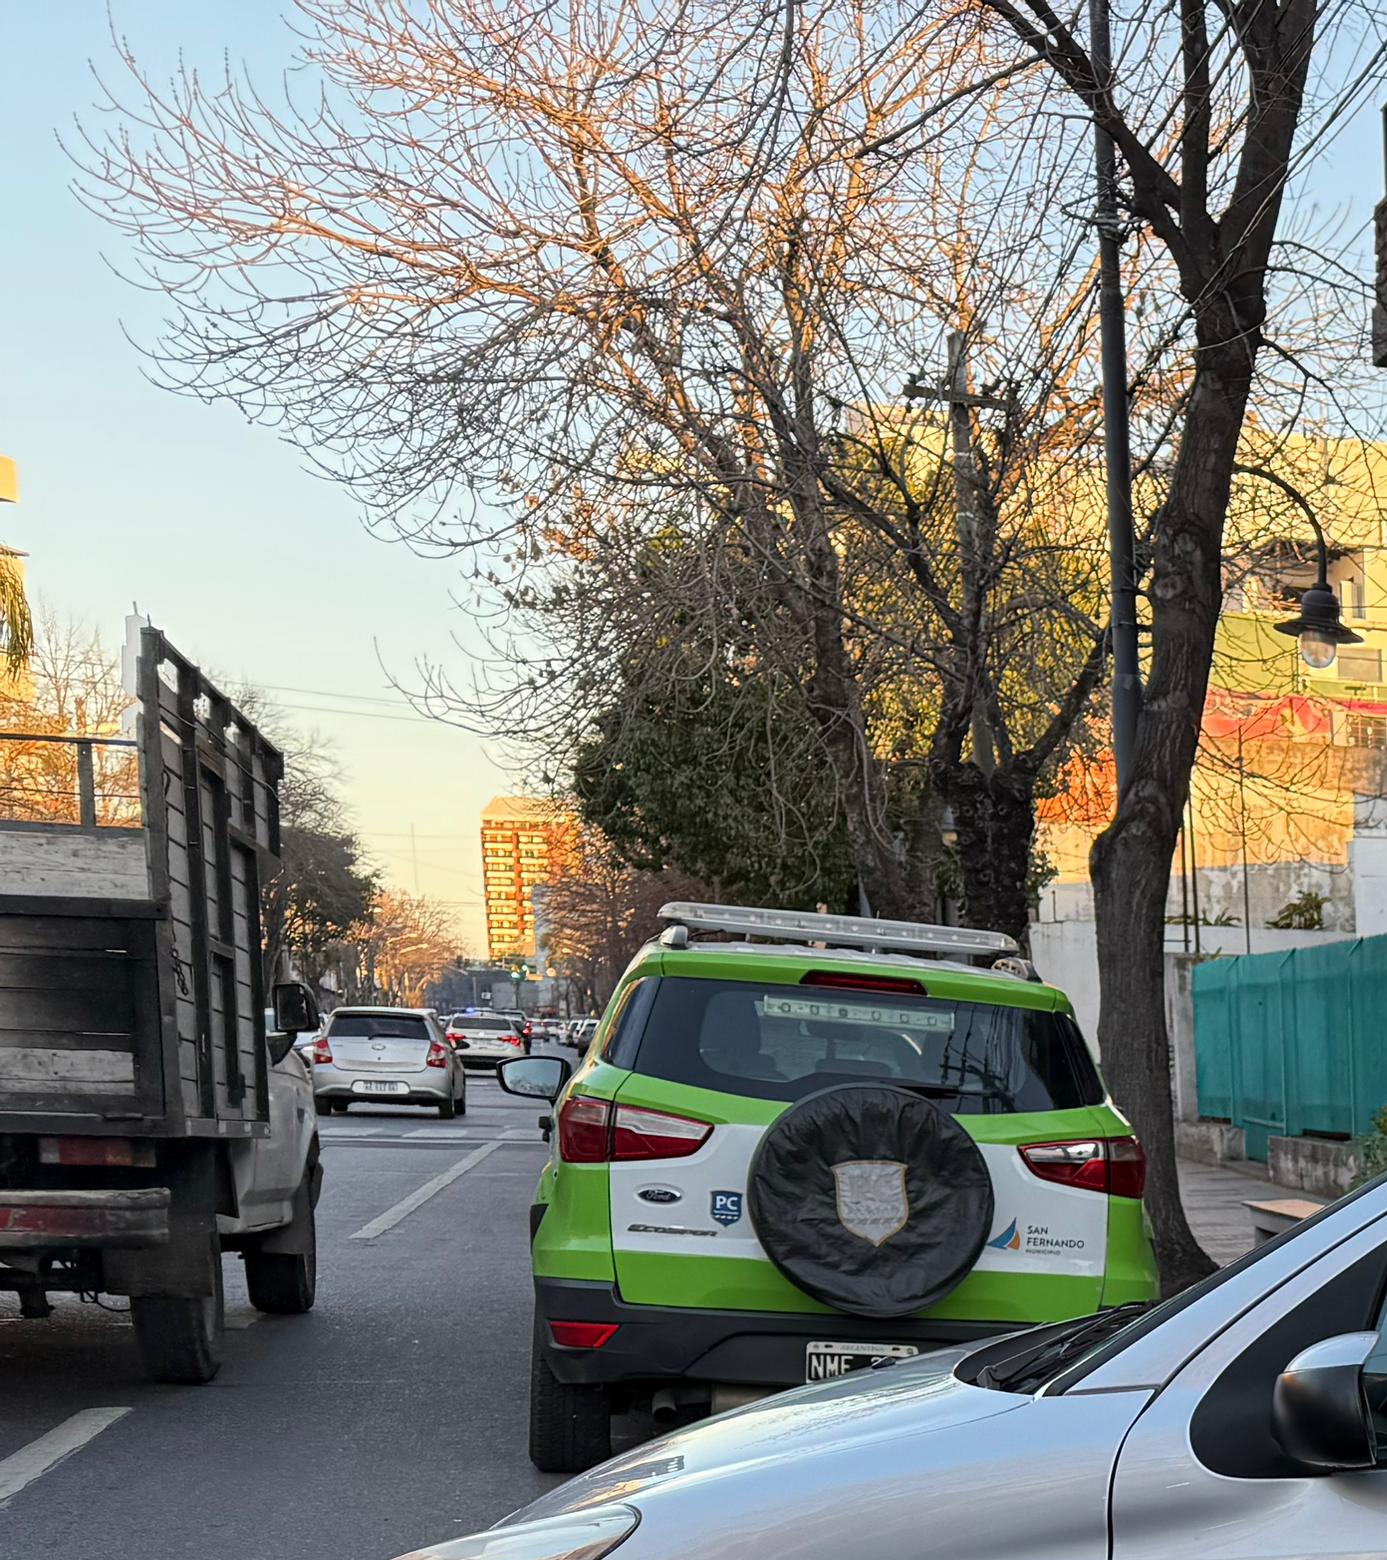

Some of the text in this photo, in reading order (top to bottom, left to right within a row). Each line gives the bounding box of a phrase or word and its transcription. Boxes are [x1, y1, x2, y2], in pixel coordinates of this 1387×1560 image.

[715, 1195, 739, 1210] PC
[1026, 1225, 1049, 1235] SAN
[1026, 1237, 1085, 1249] FERNANDO
